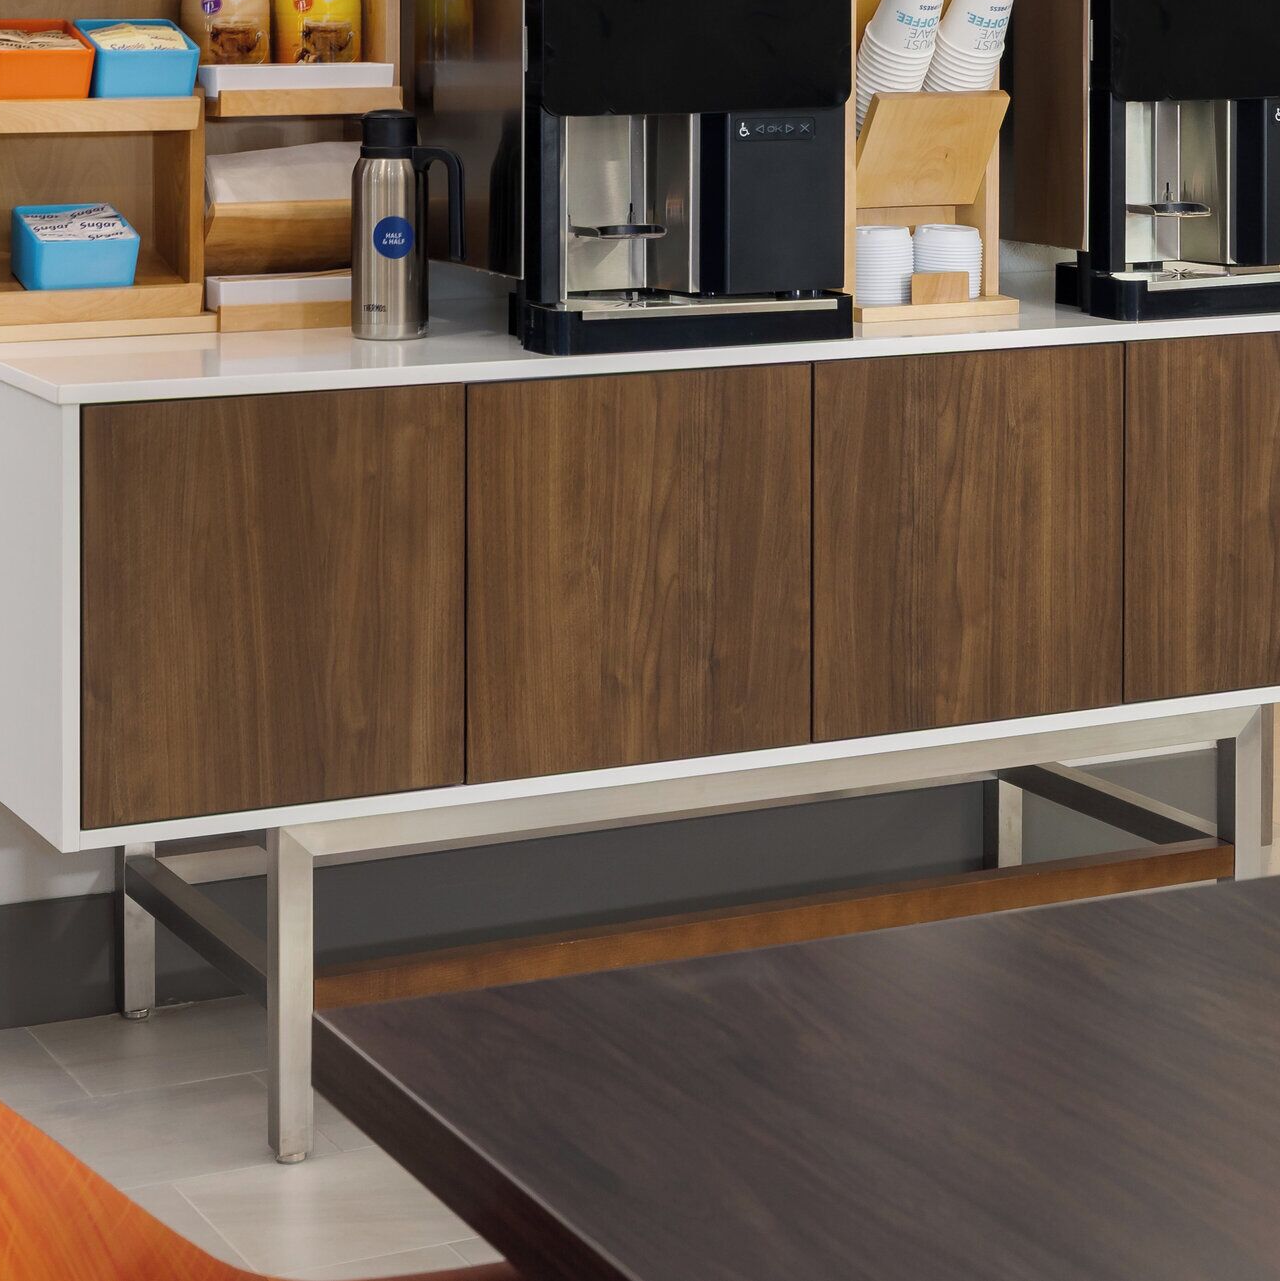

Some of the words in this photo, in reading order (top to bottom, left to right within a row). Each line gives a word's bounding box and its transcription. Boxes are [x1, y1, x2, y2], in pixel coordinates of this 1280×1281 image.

[70, 204, 106, 219] Sugar
[33, 223, 69, 232] Sugar
[80, 221, 117, 230] Sugar
